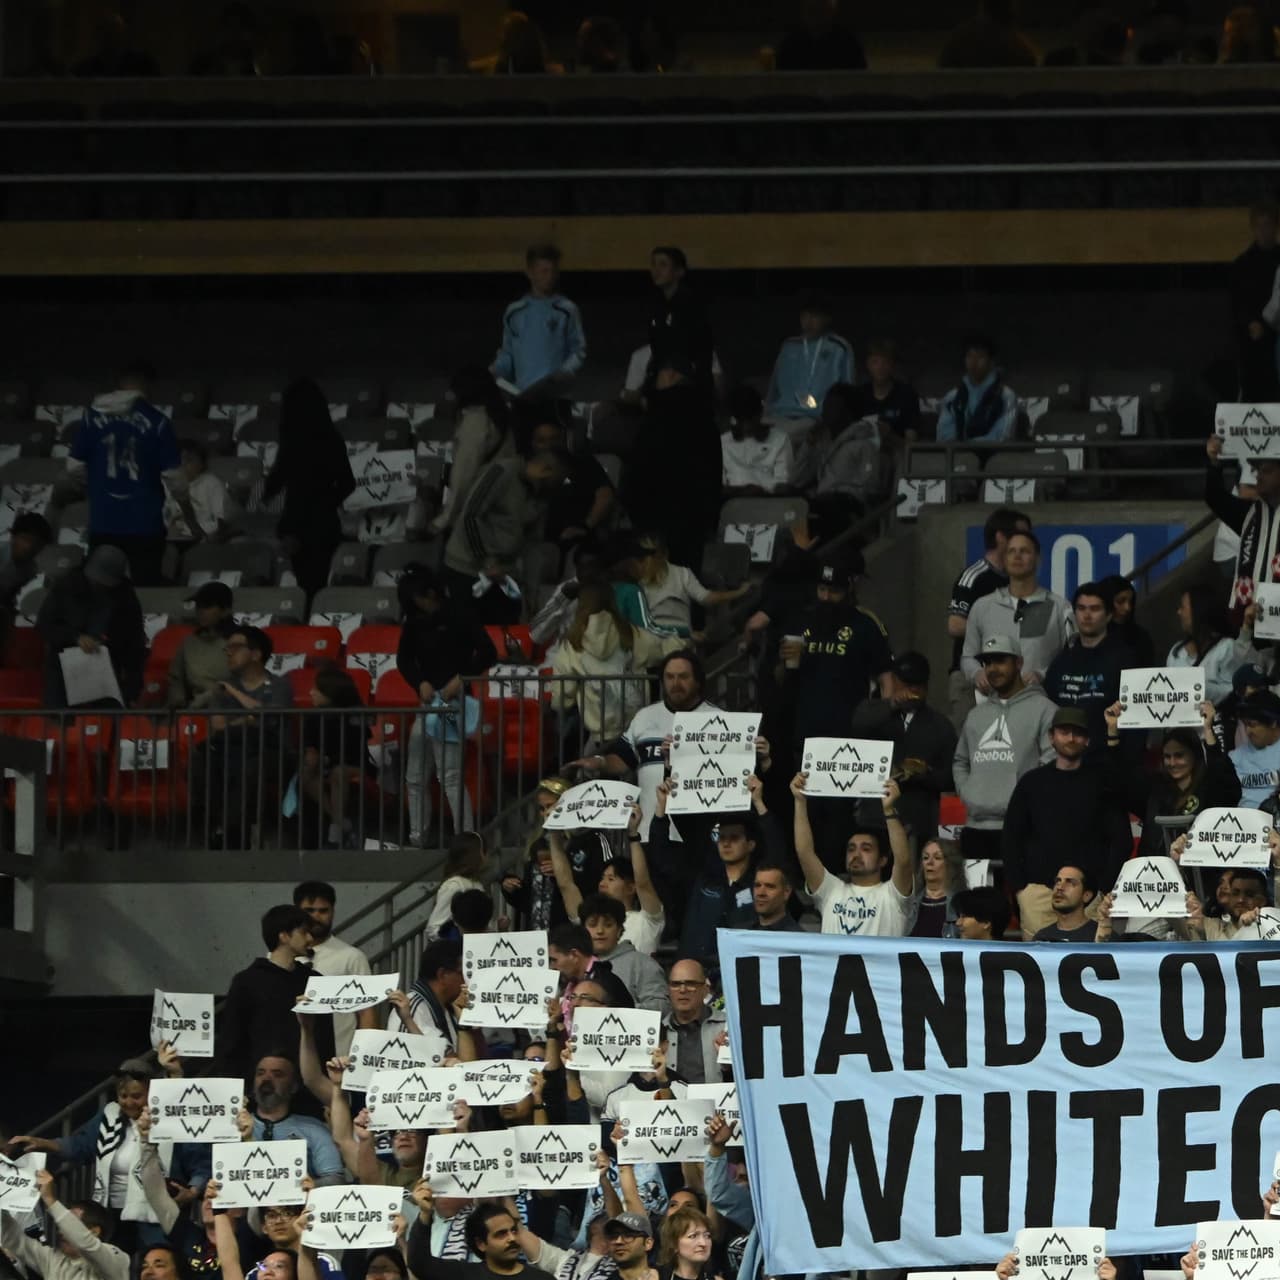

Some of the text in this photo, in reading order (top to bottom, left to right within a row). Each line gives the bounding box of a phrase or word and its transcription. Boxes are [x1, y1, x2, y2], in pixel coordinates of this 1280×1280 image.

[808, 641, 848, 656] ELUS
[1132, 692, 1152, 704] SAVE
[1166, 691, 1188, 703] CAPS
[973, 750, 1014, 763] Reebok
[815, 760, 836, 772] SAVE
[851, 761, 874, 773] CAPS
[1198, 830, 1219, 842] SAVE
[1234, 831, 1257, 843] CAPS
[736, 949, 1124, 1080] HANDS
[582, 1033, 602, 1046] SAVE
[617, 1034, 641, 1046] CAPS
[164, 1104, 186, 1117] SAVE
[202, 1104, 225, 1116] CAPS
[319, 1211, 341, 1223] SAVE
[357, 1210, 382, 1222] CAPS
[1025, 1254, 1047, 1267] SAVE
[1063, 1253, 1087, 1266] CAPS
